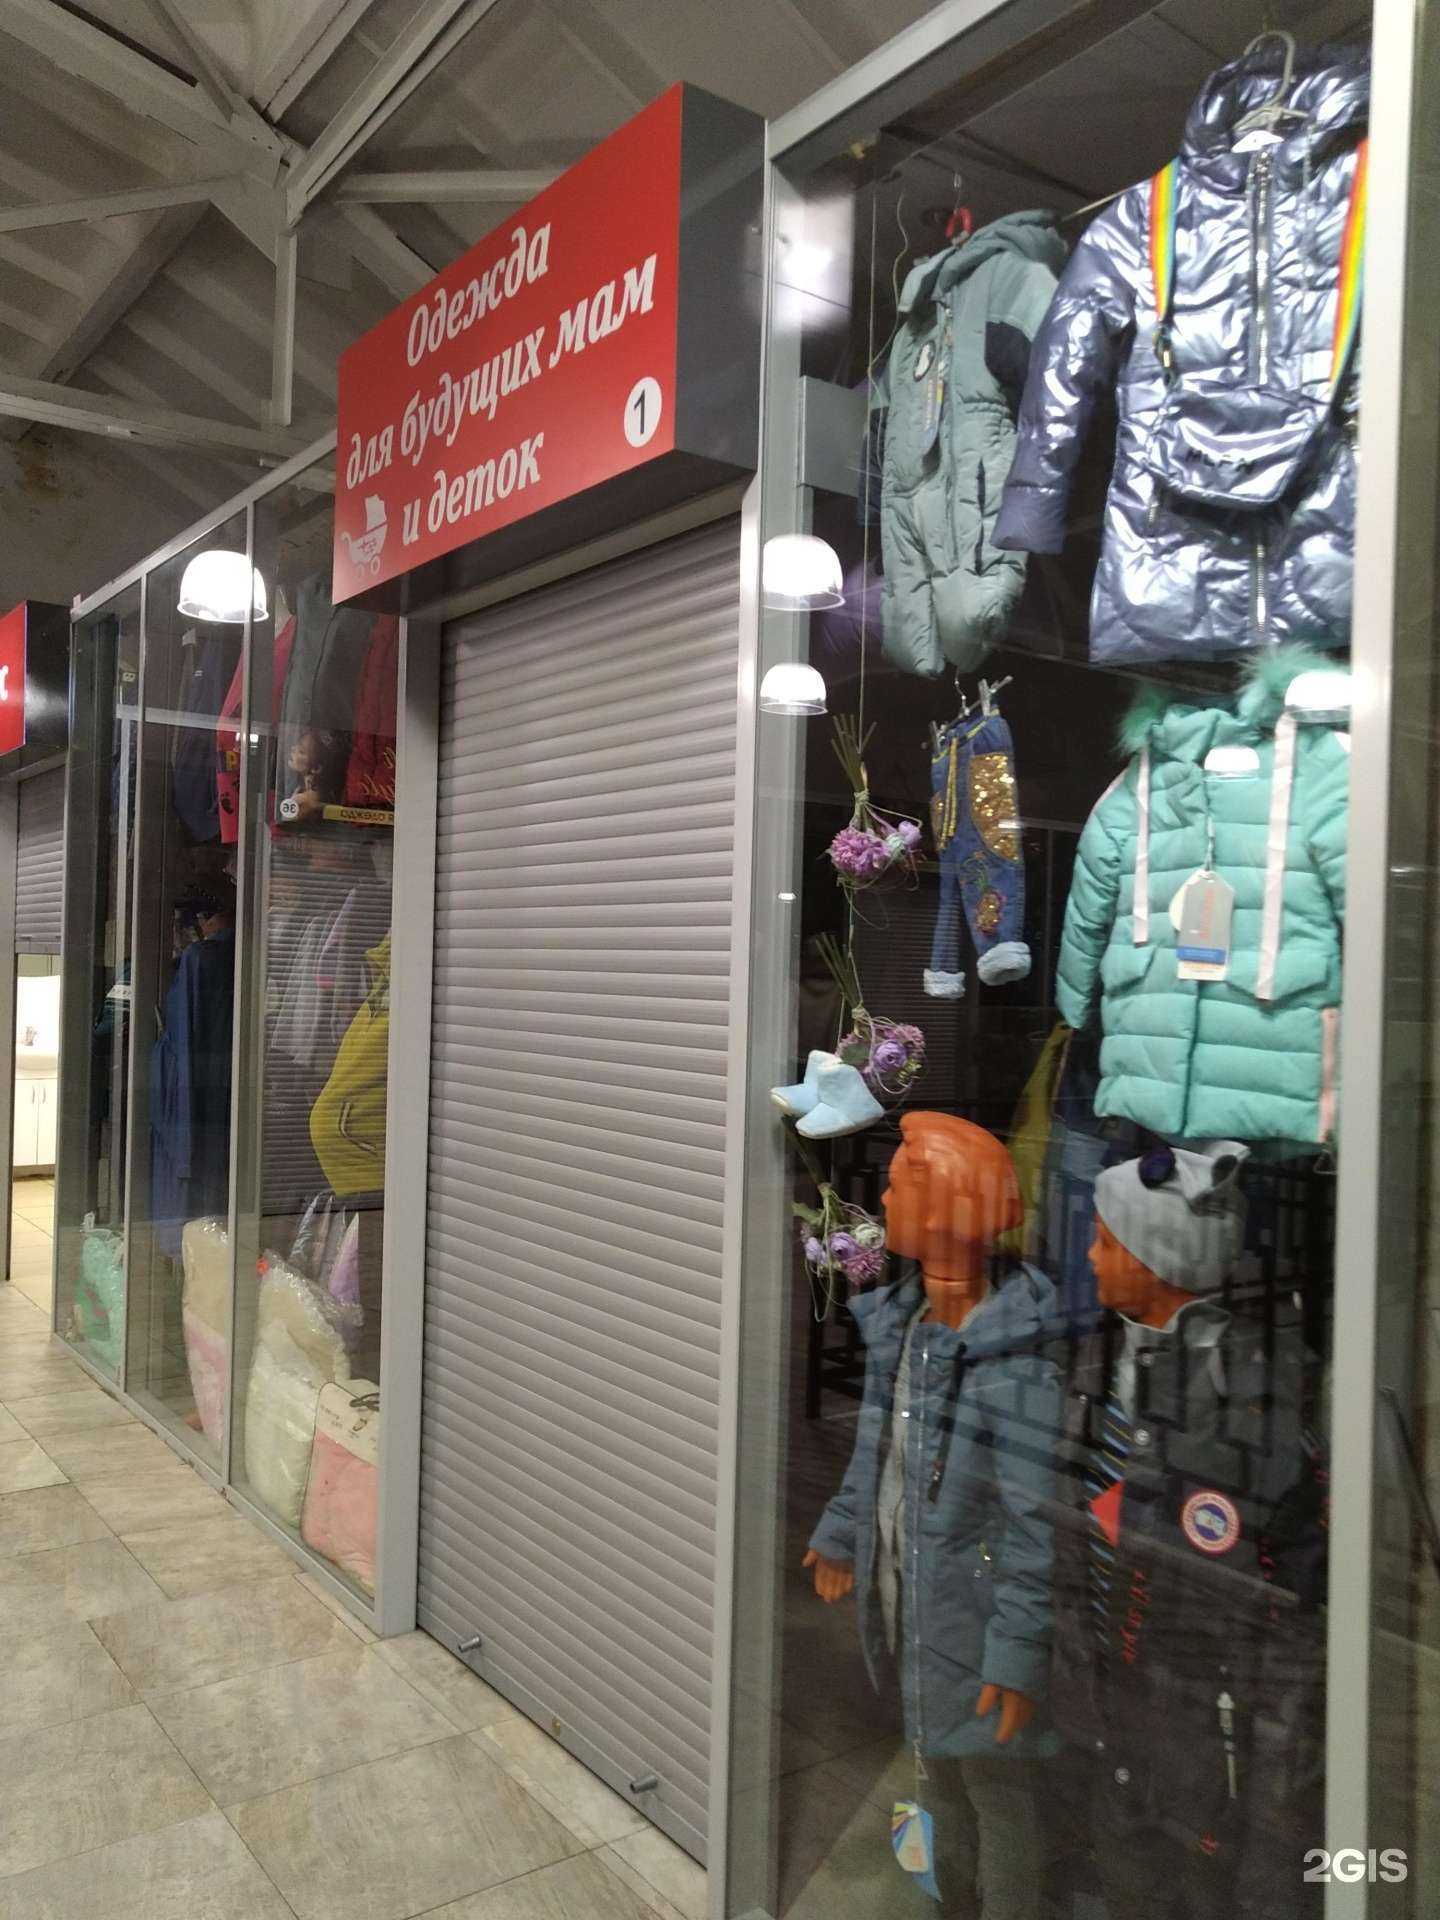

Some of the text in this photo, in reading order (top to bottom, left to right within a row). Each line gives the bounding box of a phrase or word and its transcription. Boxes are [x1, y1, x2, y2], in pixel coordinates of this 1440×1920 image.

[407, 223, 551, 367] Одежда
[346, 254, 657, 490] для будущих мам
[633, 389, 647, 436] 1
[402, 432, 545, 546] и деток
